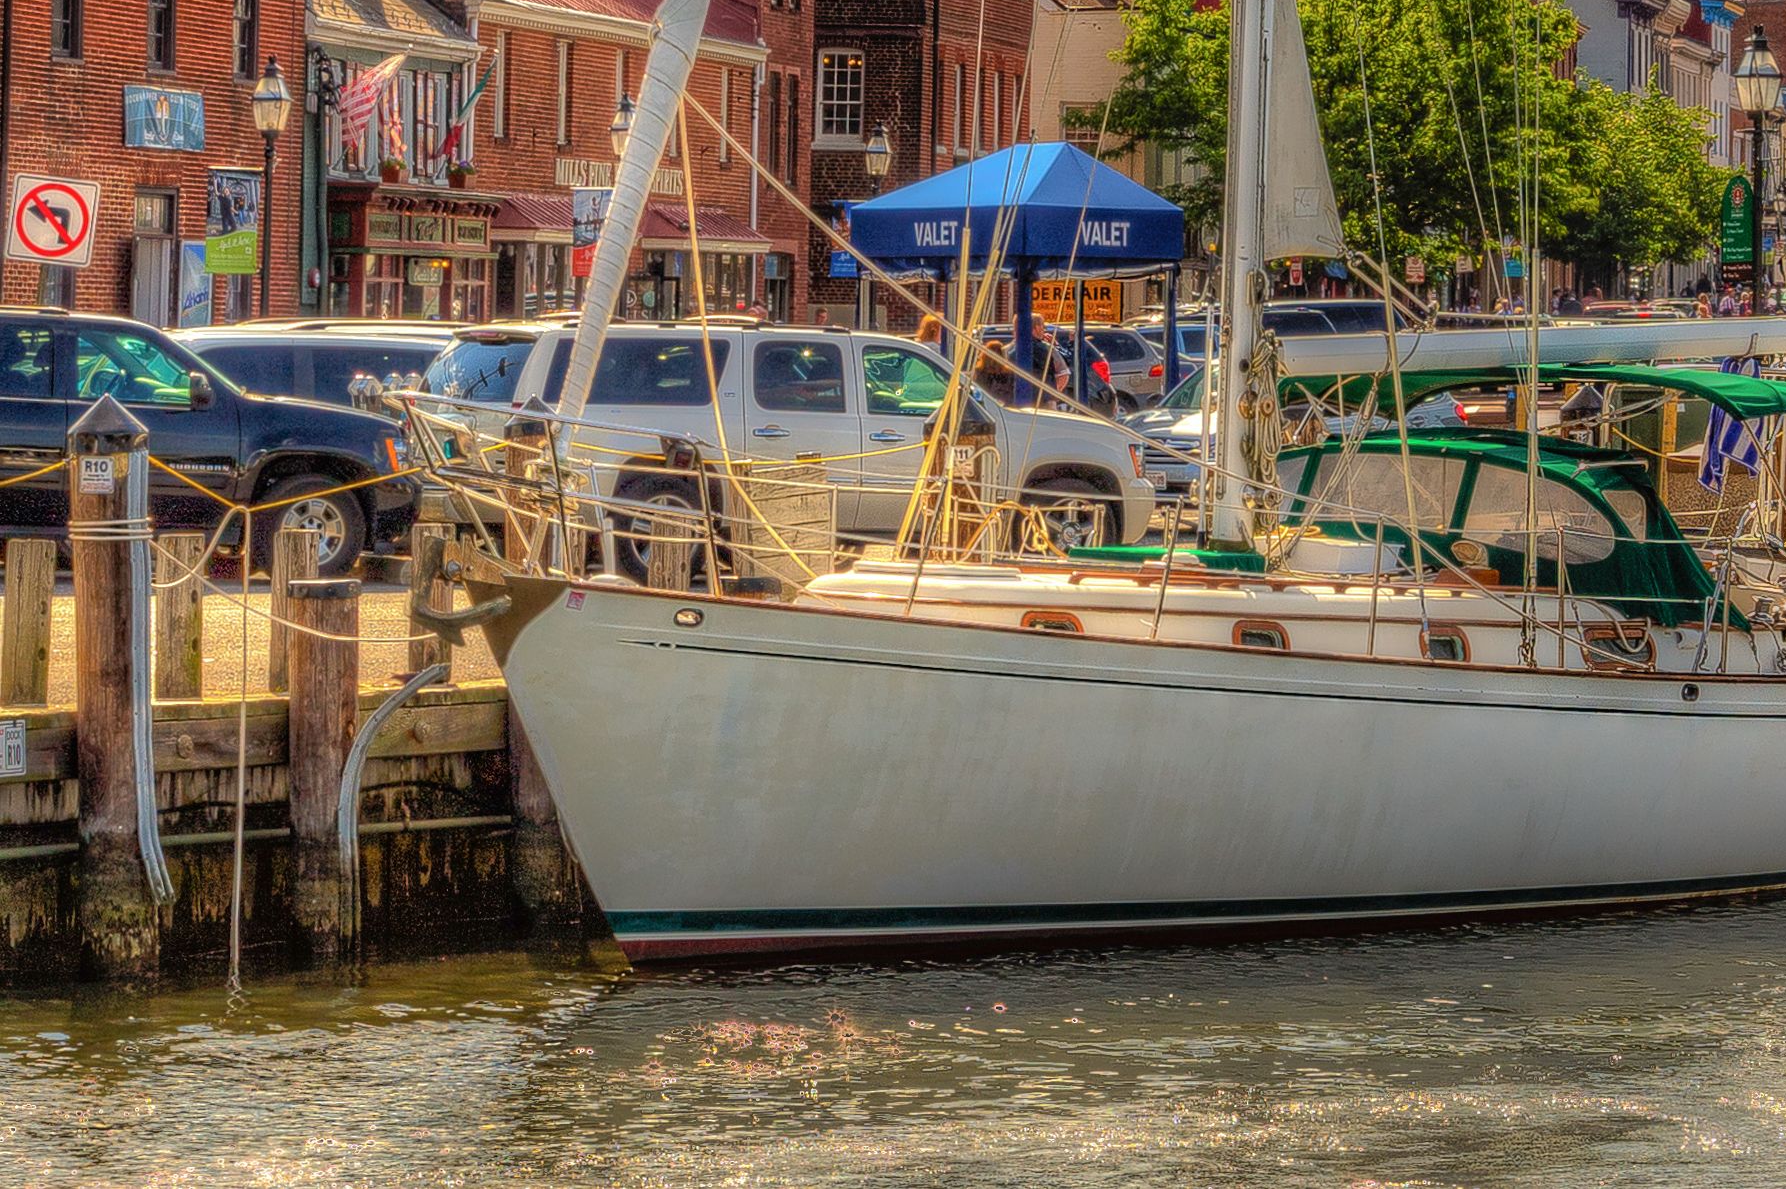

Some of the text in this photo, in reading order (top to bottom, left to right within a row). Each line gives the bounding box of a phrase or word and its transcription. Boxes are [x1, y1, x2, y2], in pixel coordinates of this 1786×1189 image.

[556, 158, 588, 186] MILLS
[589, 162, 612, 187] FINE
[914, 221, 957, 247] VALET
[1081, 221, 1130, 247] VALET
[1053, 287, 1112, 301] REAIR
[85, 461, 108, 473] R10
[169, 464, 230, 472] SUBURBAN
[7, 731, 20, 741] DOCK
[8, 744, 20, 765] R10
